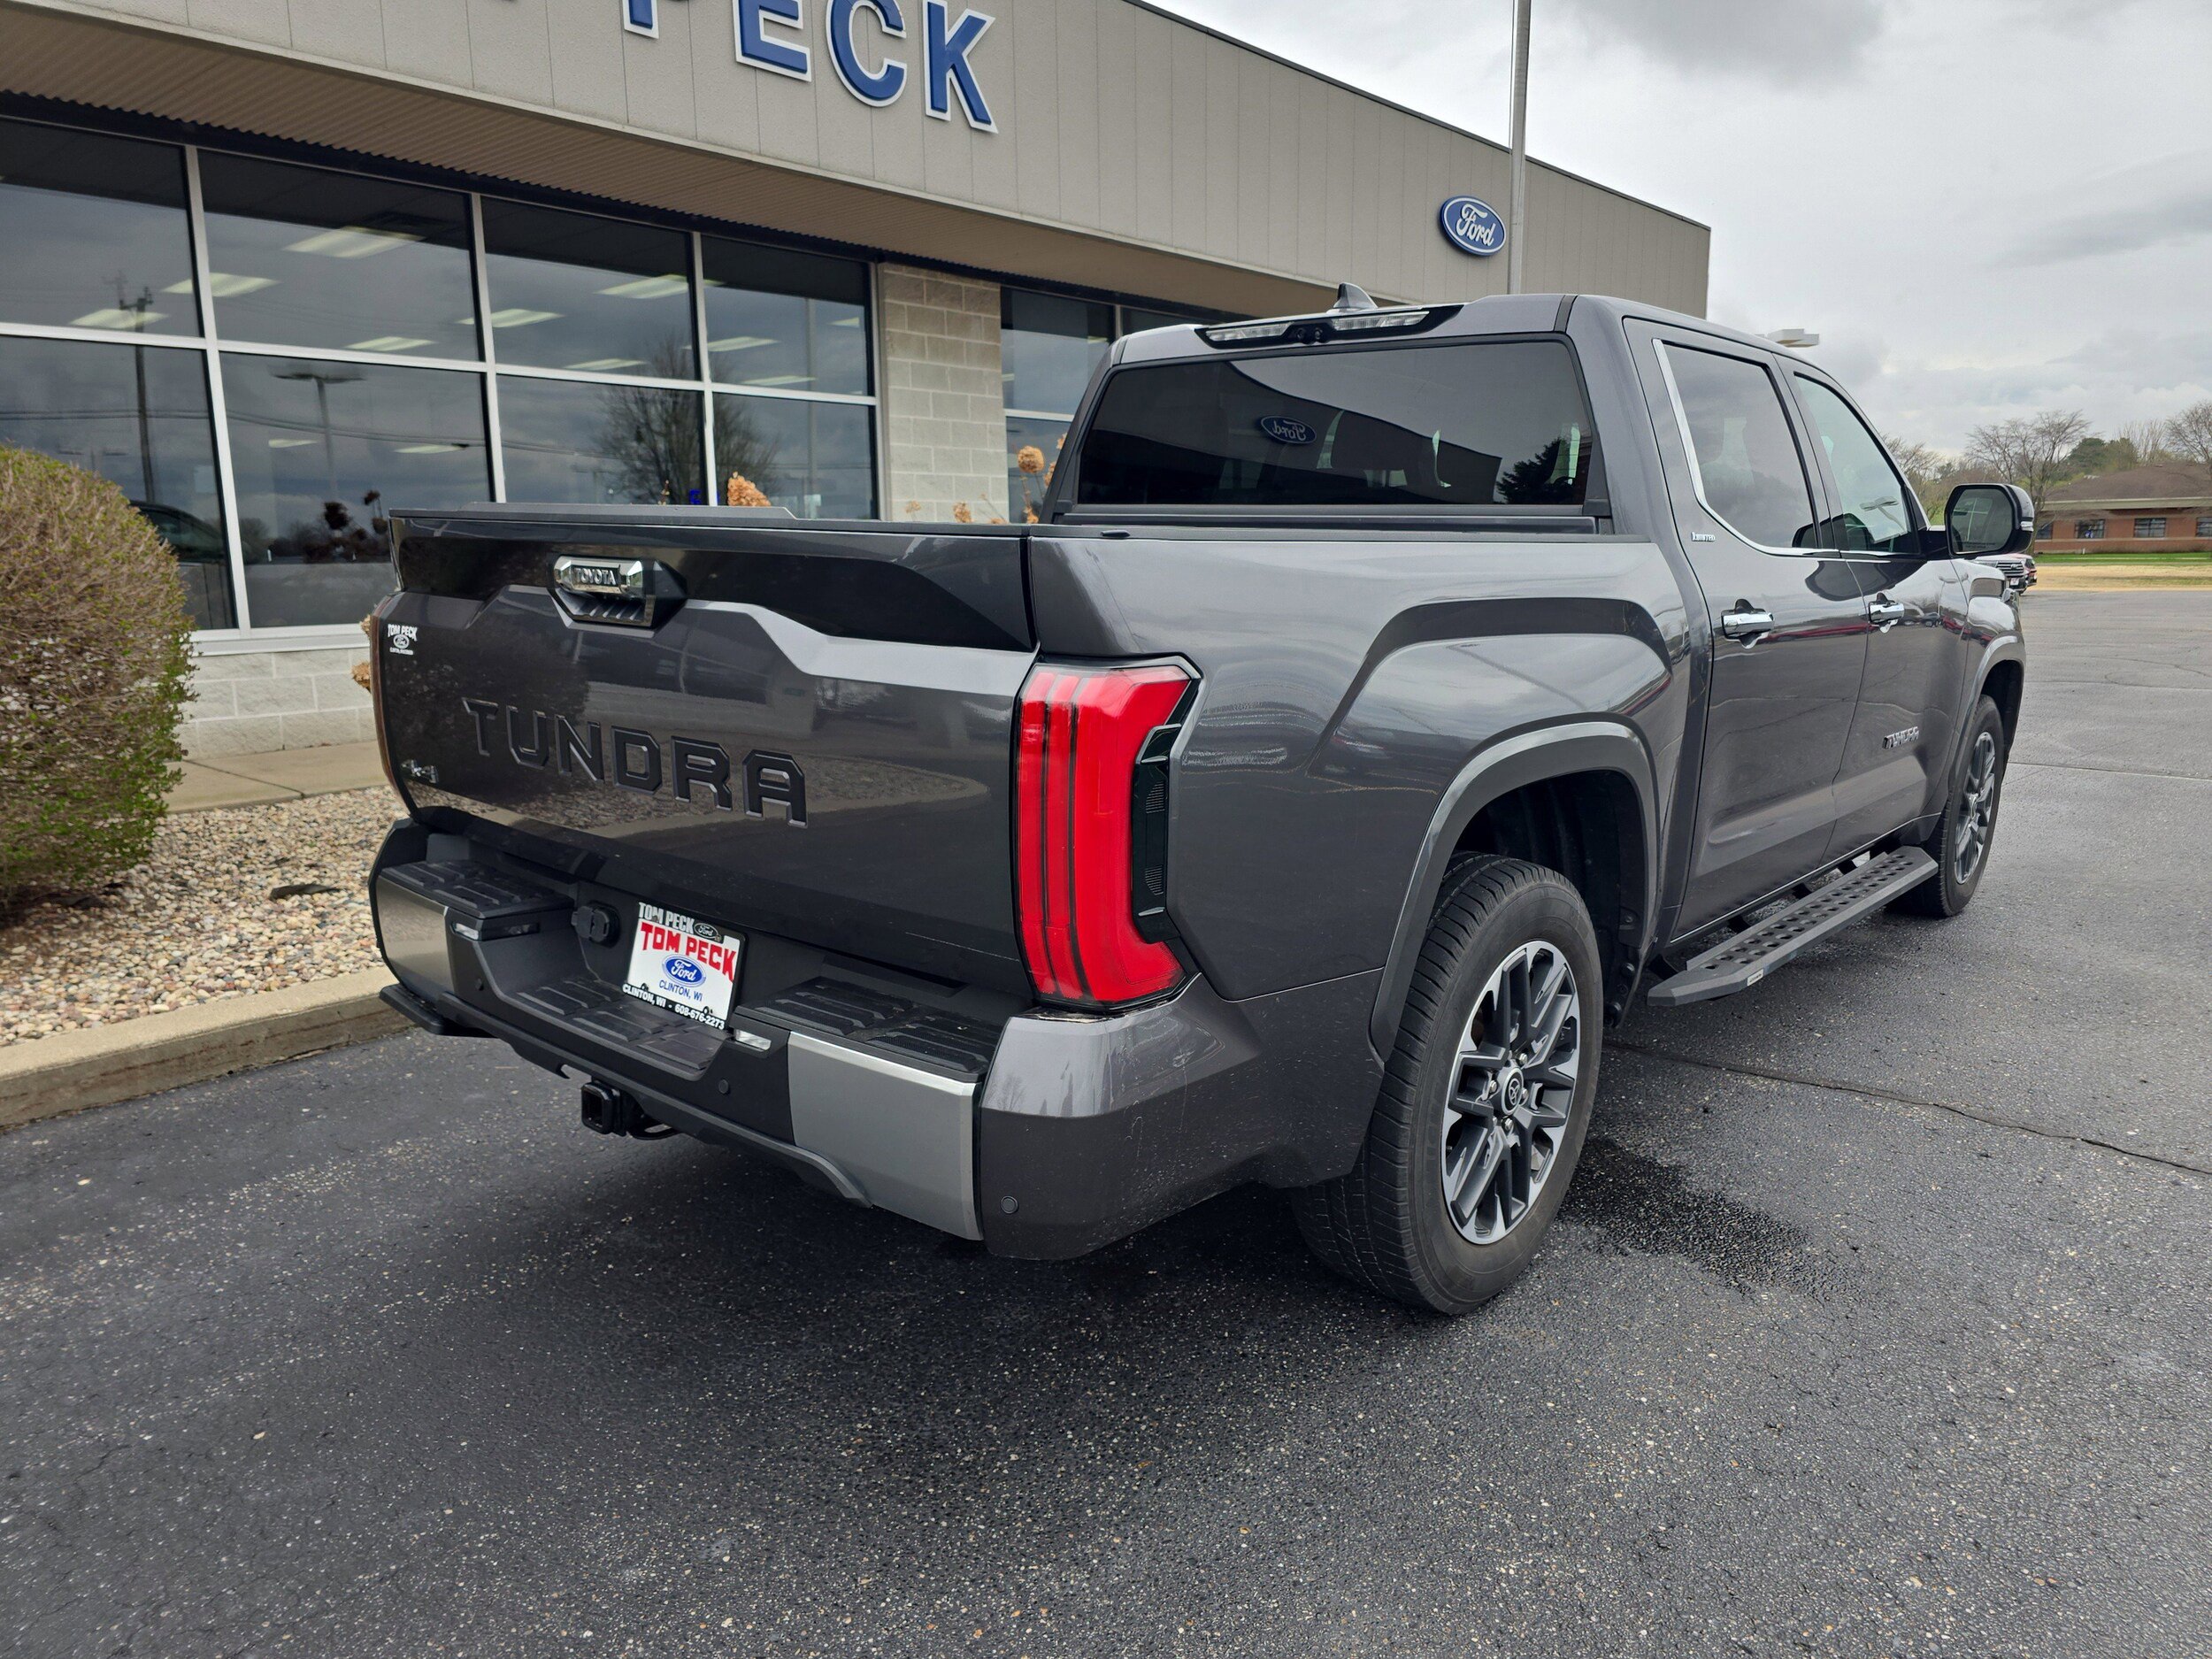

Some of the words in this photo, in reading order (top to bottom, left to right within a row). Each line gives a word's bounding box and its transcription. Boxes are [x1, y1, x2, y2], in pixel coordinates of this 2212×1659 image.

[622, 0, 999, 134] ECK
[1456, 204, 1496, 246] Ford
[574, 567, 617, 586] TOYOTA
[461, 696, 808, 828] TUNDRA
[638, 902, 664, 925] TOM
[664, 910, 695, 934] PECK
[641, 921, 680, 954] TOM
[685, 936, 736, 983] PECK
[622, 983, 656, 1005] CLINTON,
[655, 997, 667, 1008] WI
[674, 1003, 726, 1030] 608-676-2273
[658, 979, 691, 999] CLINTON,
[693, 992, 703, 1002] WI
